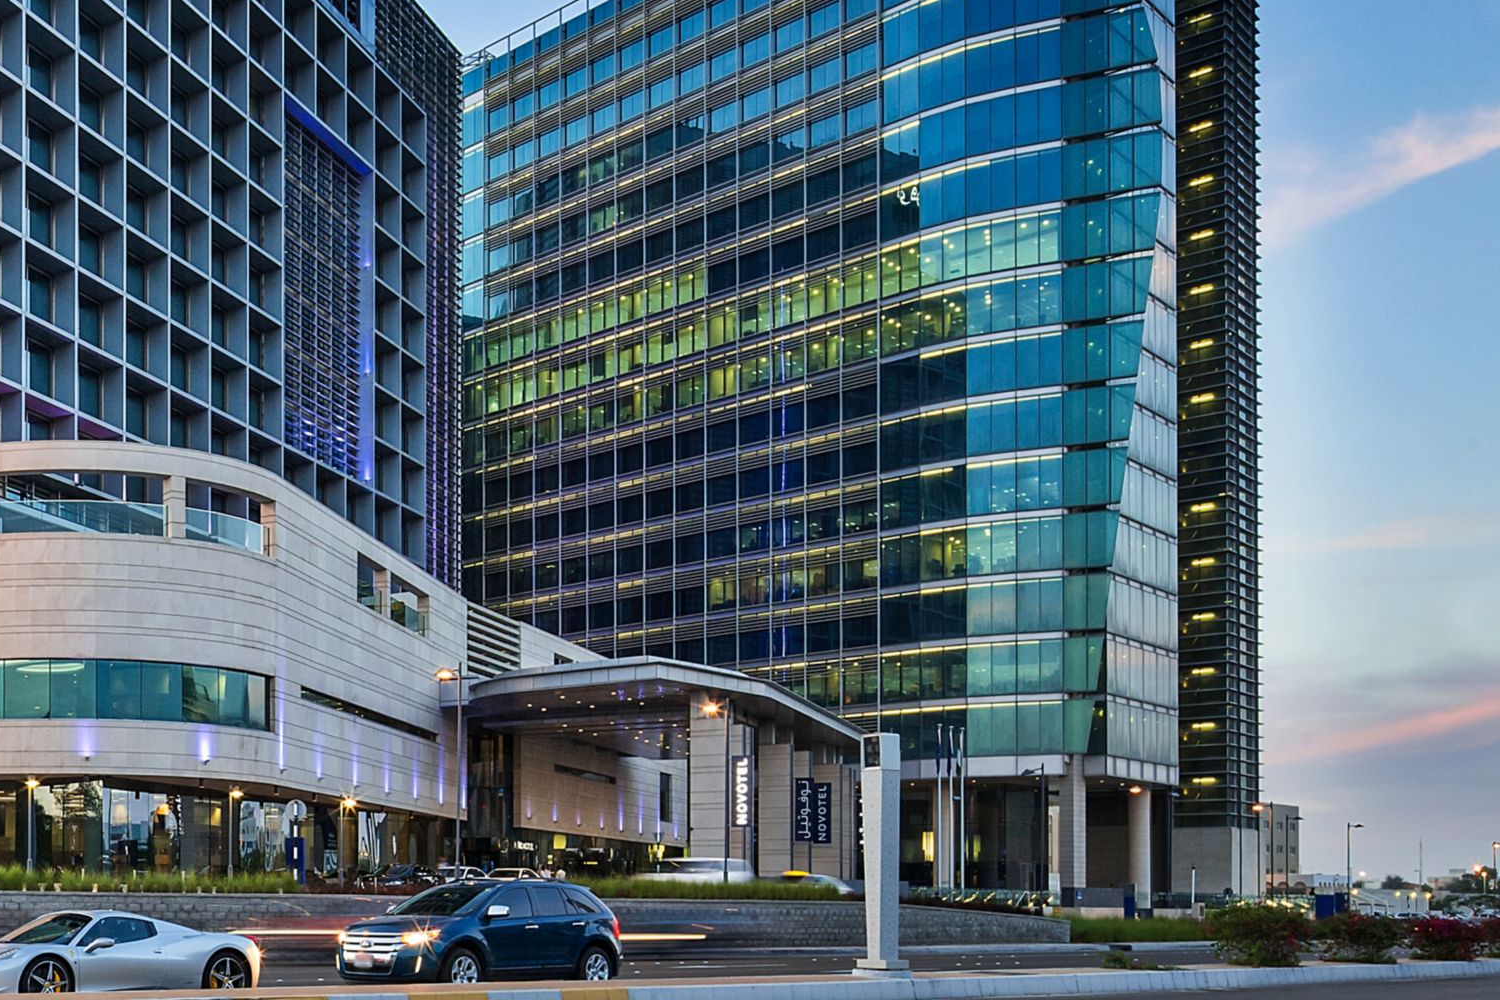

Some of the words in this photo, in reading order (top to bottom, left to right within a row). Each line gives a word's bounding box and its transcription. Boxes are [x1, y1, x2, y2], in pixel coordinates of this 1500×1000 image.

[736, 758, 748, 826] NOVOTEL
[798, 780, 811, 839] نوفوتيل
[818, 785, 827, 841] NOVOTEL
